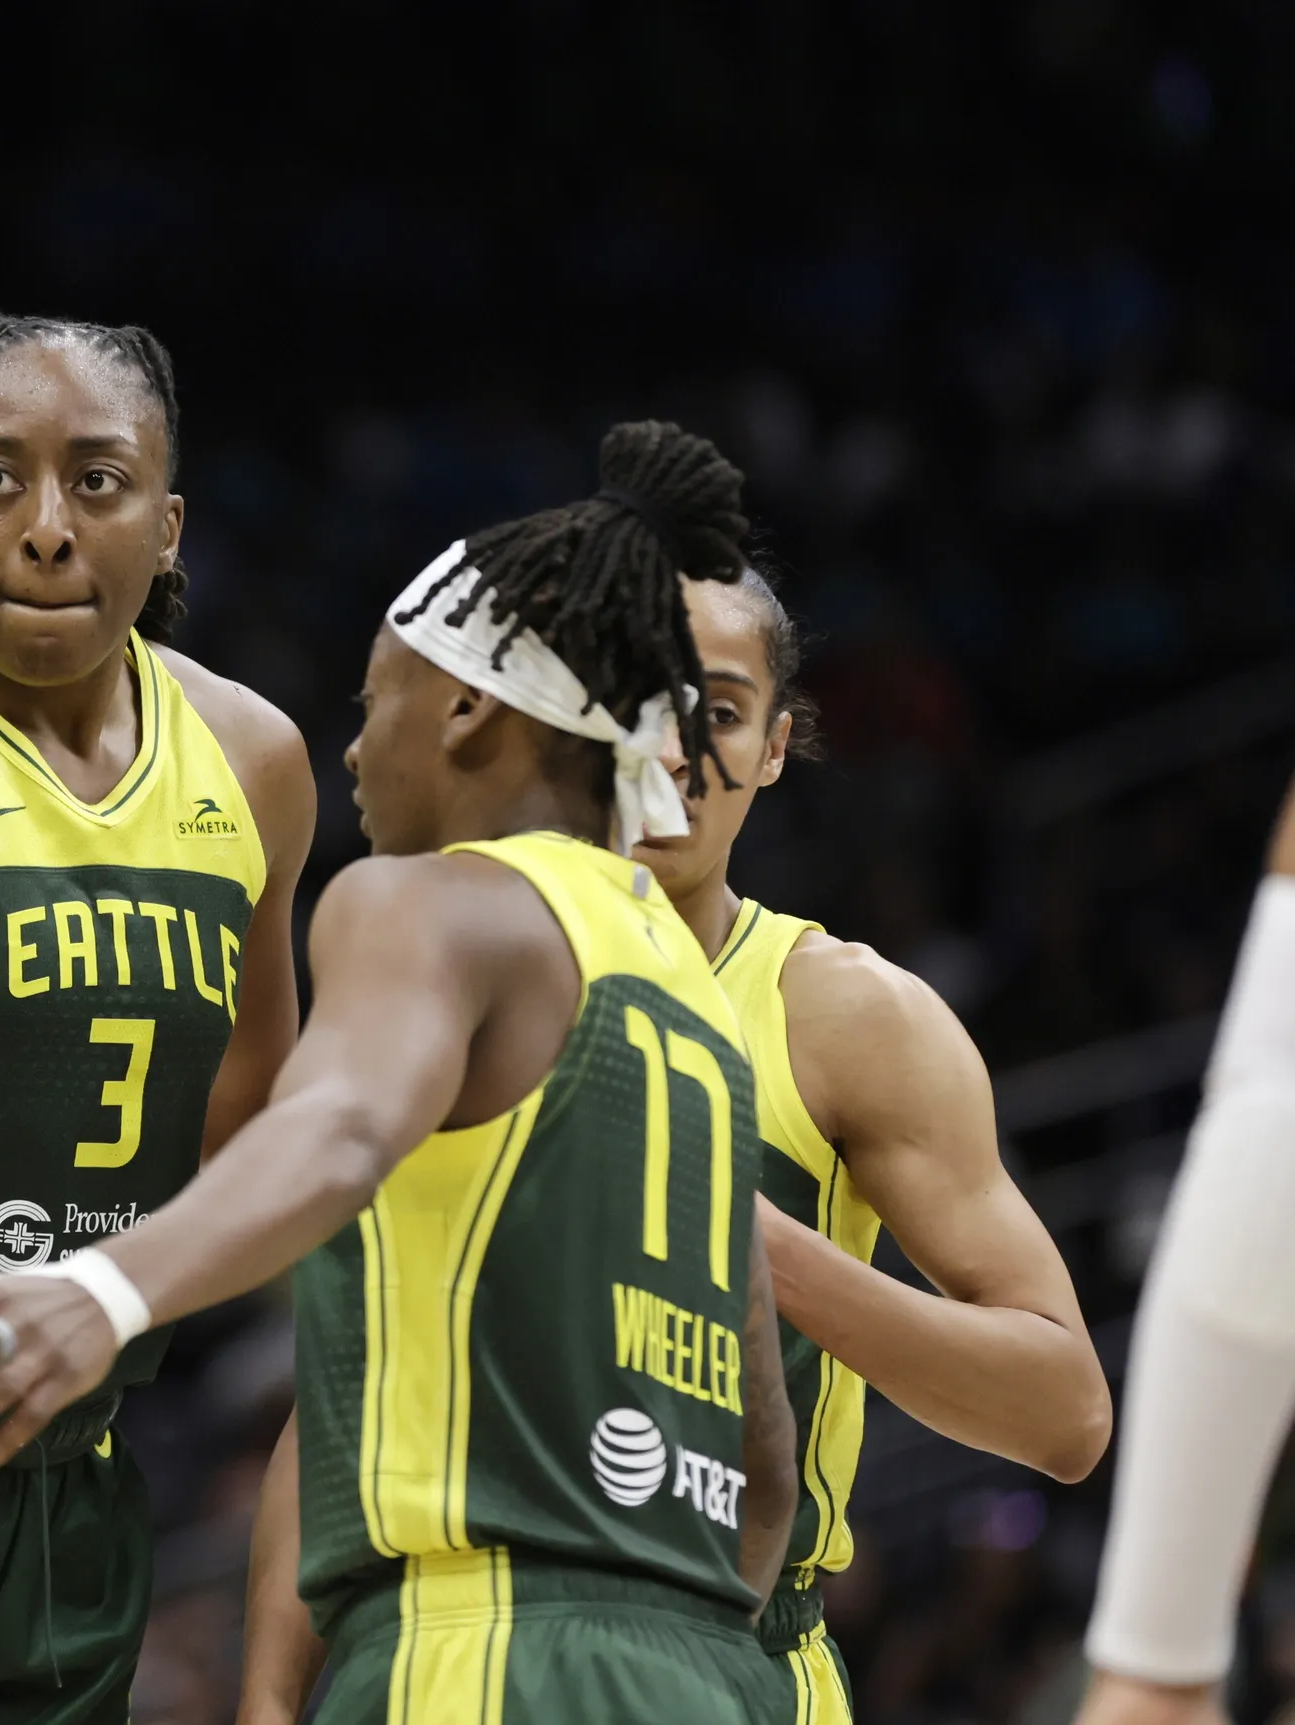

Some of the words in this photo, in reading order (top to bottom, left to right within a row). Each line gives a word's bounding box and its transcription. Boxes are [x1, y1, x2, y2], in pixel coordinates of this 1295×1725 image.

[178, 821, 238, 835] SYMETRA
[73, 1017, 156, 1169] 3
[624, 1004, 733, 1293] 17
[62, 1201, 158, 1234] Provide
[612, 1281, 744, 1417] WHEELER
[671, 1444, 747, 1530] AT&T
